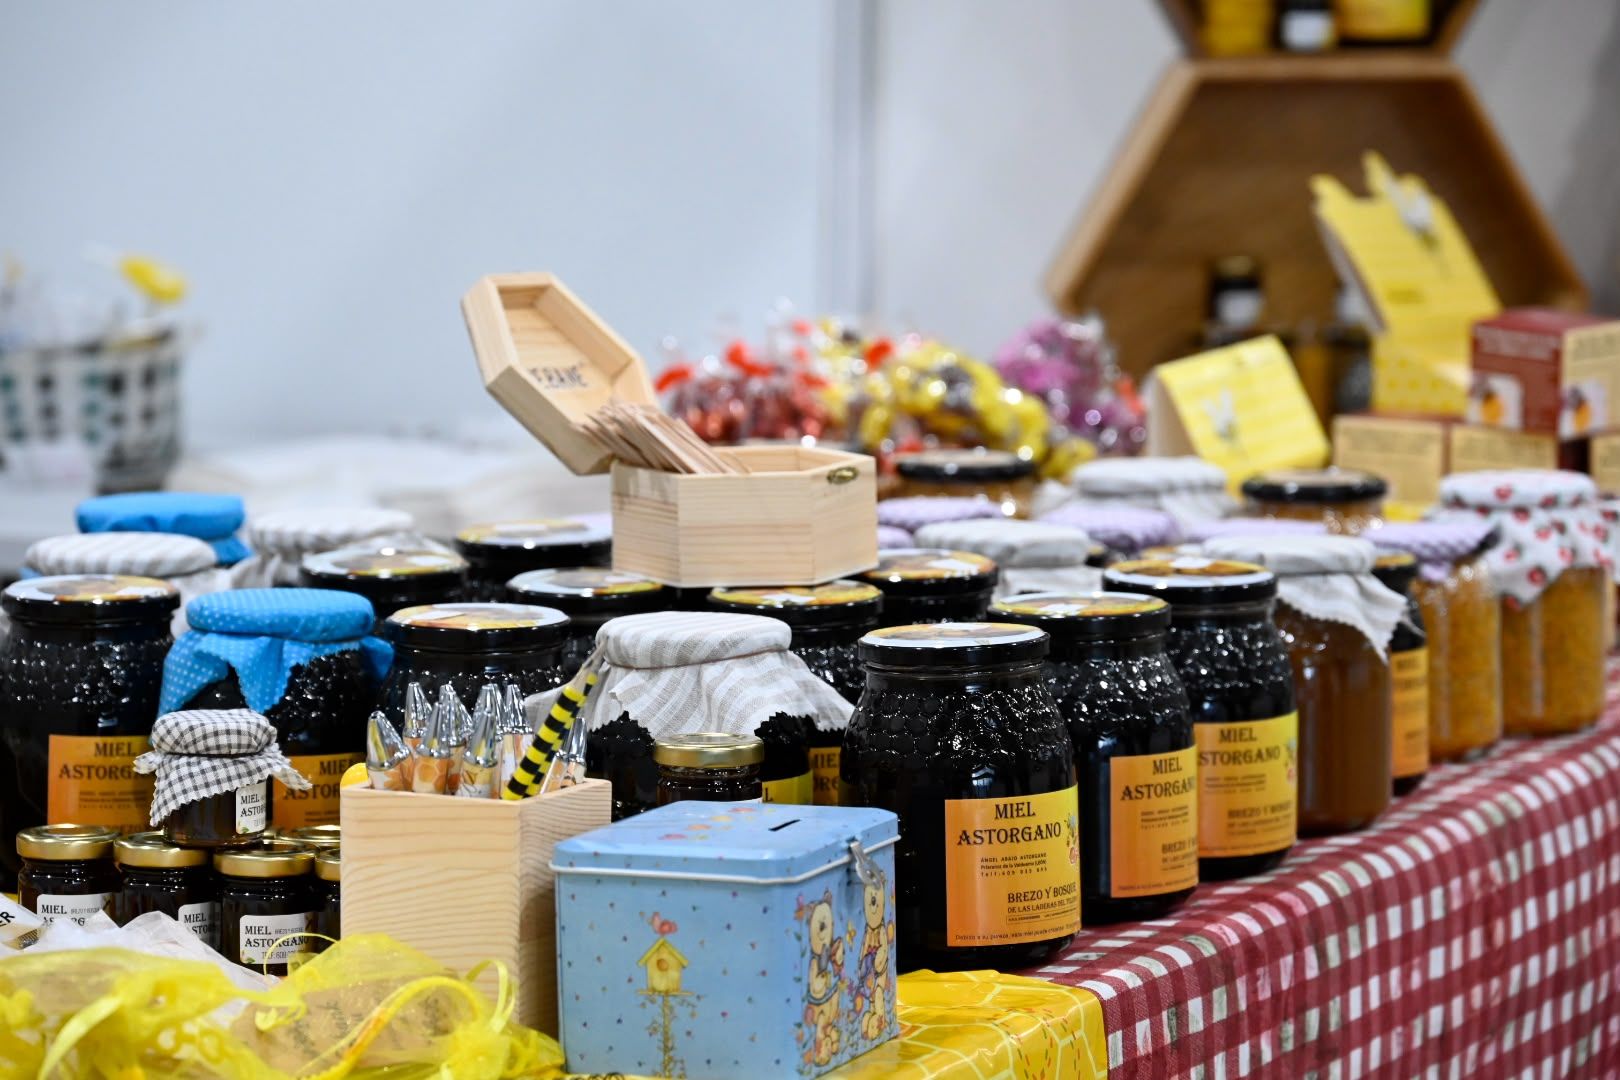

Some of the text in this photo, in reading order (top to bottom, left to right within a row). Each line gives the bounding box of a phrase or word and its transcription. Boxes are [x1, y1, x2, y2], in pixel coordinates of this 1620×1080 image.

[1219, 728, 1258, 743] MIEL
[94, 742, 137, 757] MIEL
[1198, 746, 1281, 766] STORGANO
[1152, 757, 1183, 775] MIEL
[241, 794, 260, 805] MIEL
[995, 802, 1036, 820] MIEL
[957, 822, 1062, 846] ASTORGANO
[1008, 890, 1043, 904] BREZO
[1045, 887, 1052, 899] Y
[41, 904, 68, 915] MIEL
[1008, 906, 1017, 914] DE
[1017, 904, 1031, 912] LAS
[1032, 901, 1057, 911] LADERAS
[184, 913, 207, 923] MIEL
[244, 925, 272, 935] MIEL
